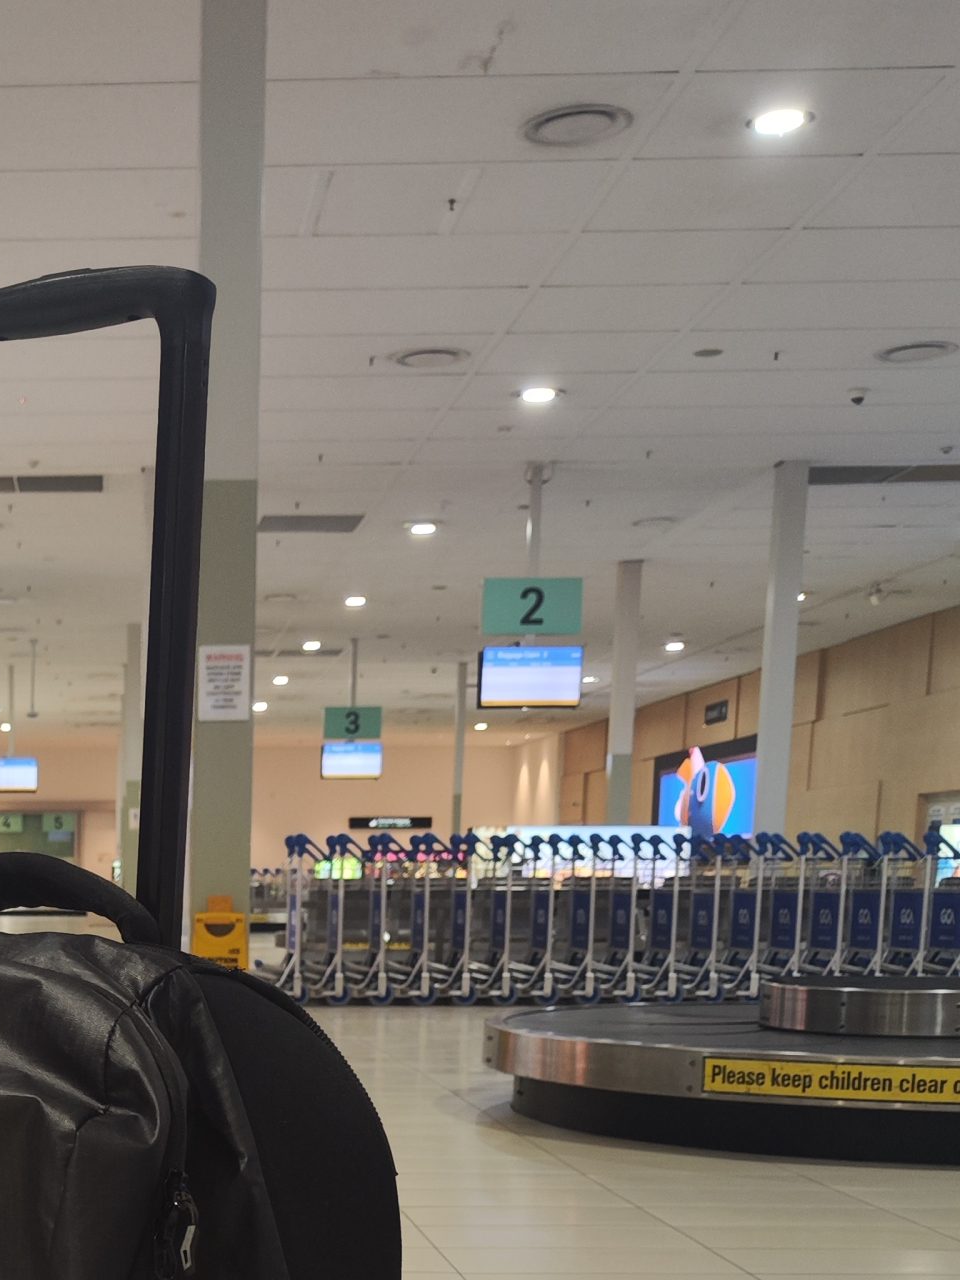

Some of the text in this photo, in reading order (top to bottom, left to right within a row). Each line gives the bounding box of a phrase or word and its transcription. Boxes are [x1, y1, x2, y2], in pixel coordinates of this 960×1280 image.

[519, 586, 545, 626] 2
[344, 711, 360, 735] 3
[711, 1064, 765, 1087] Please
[771, 1068, 813, 1093] keep
[819, 1070, 892, 1092] children
[899, 1073, 947, 1095] clear
